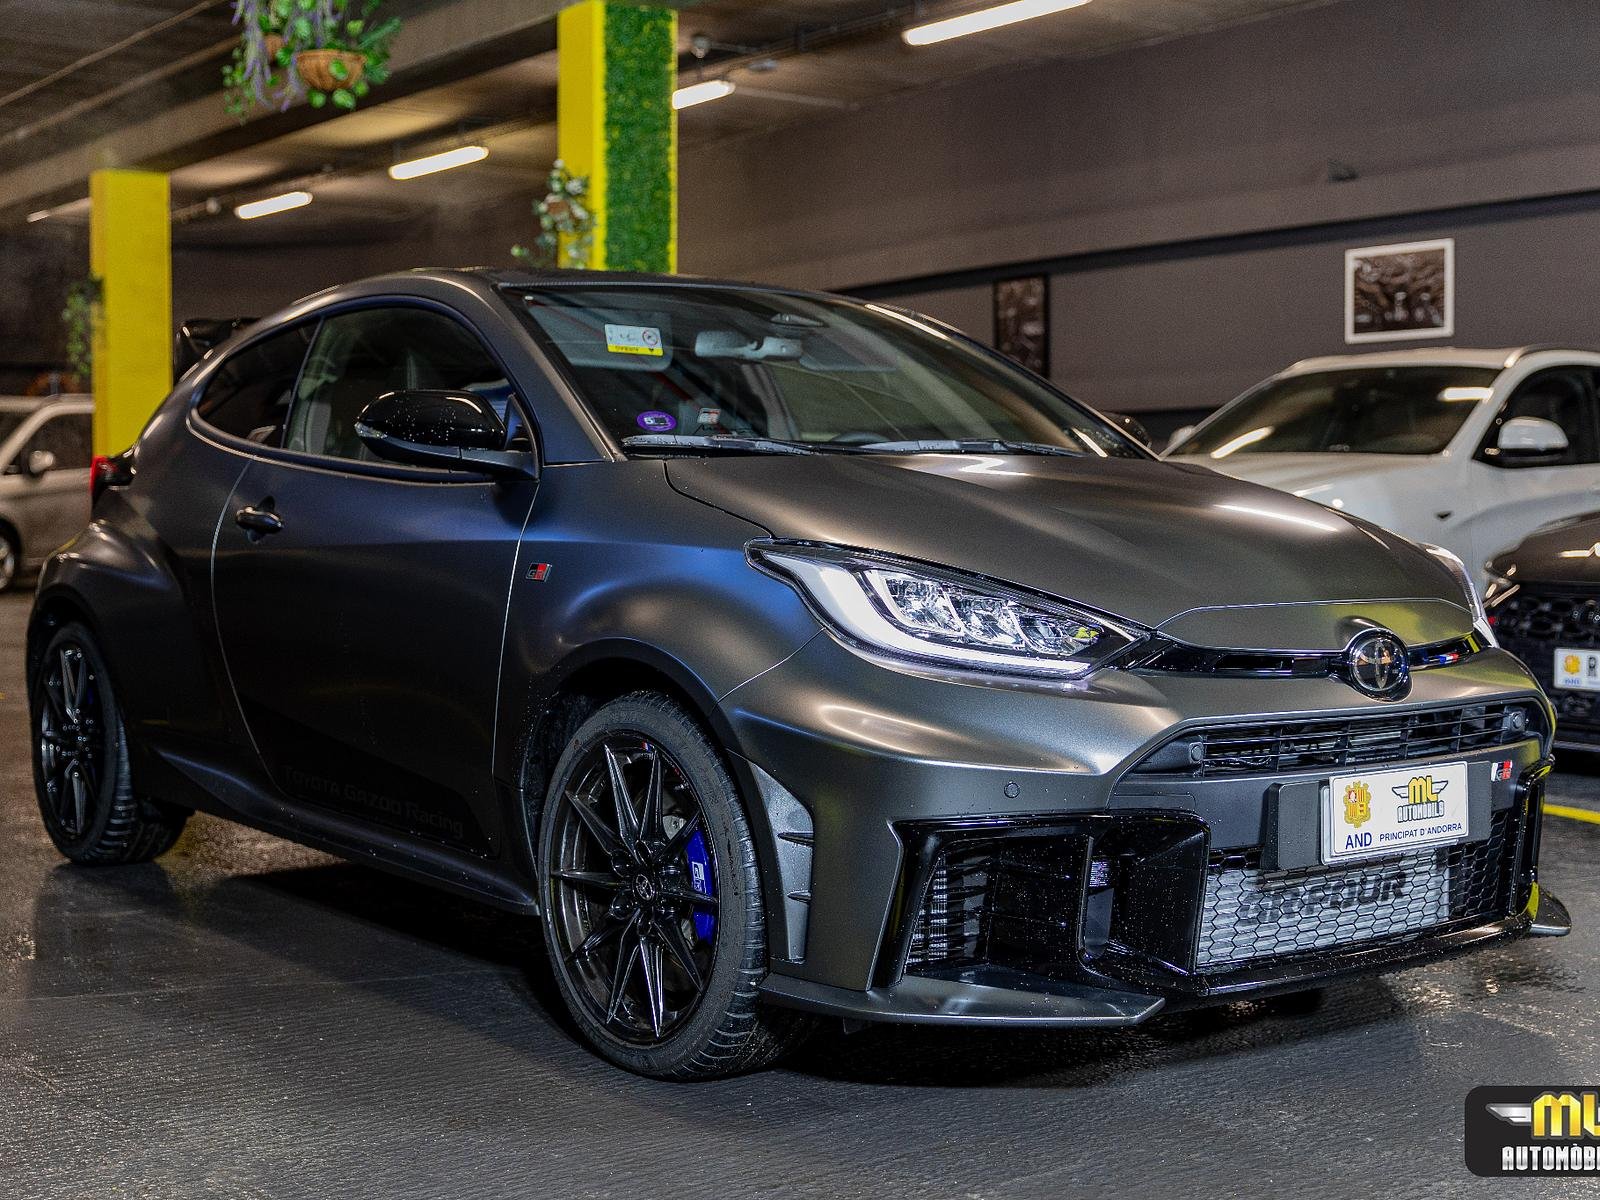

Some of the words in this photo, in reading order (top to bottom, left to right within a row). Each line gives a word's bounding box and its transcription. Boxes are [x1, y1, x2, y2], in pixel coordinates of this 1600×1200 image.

[284, 767, 340, 796] TOYOTA
[405, 801, 464, 840] Racing
[1408, 775, 1439, 805] ML
[1345, 832, 1372, 850] AND
[1379, 828, 1418, 842] PRINCIPAT
[1420, 823, 1462, 837] D'ANDORRA
